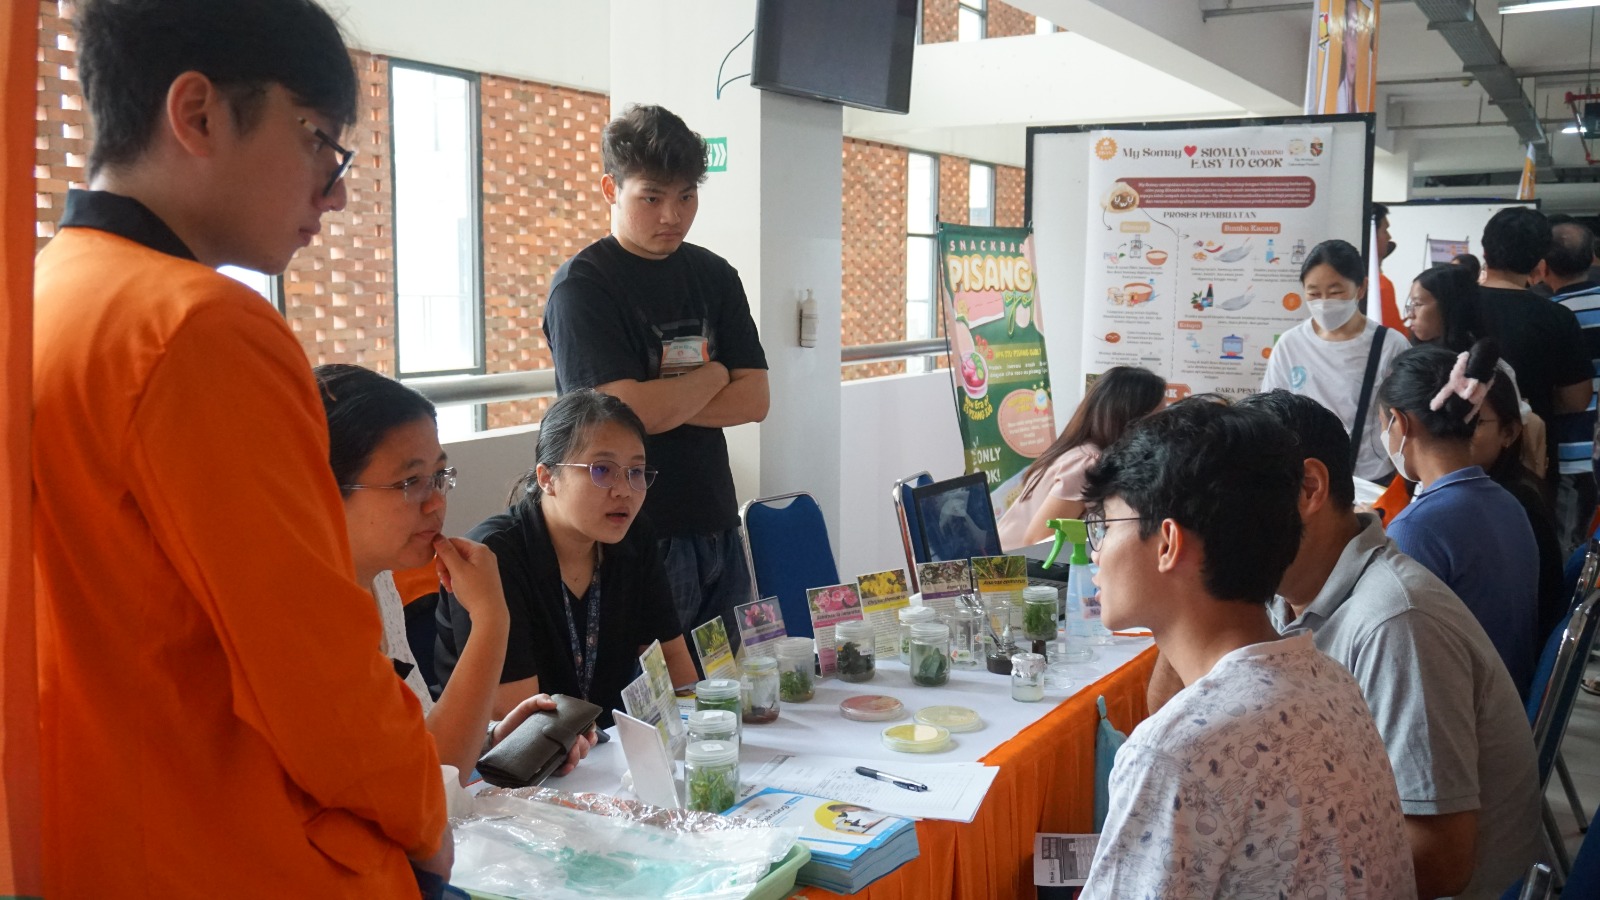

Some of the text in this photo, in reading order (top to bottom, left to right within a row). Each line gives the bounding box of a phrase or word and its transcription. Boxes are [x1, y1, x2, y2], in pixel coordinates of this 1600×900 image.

[1200, 147, 1249, 158] SIOMAY
[1191, 157, 1283, 168] EASY TO COOK
[1200, 211, 1256, 219] PEMBUATAN
[950, 240, 1024, 254] SNACKBAR
[948, 254, 1033, 292] PISANG
[974, 399, 984, 410] Era
[977, 446, 1001, 464] ONLY
